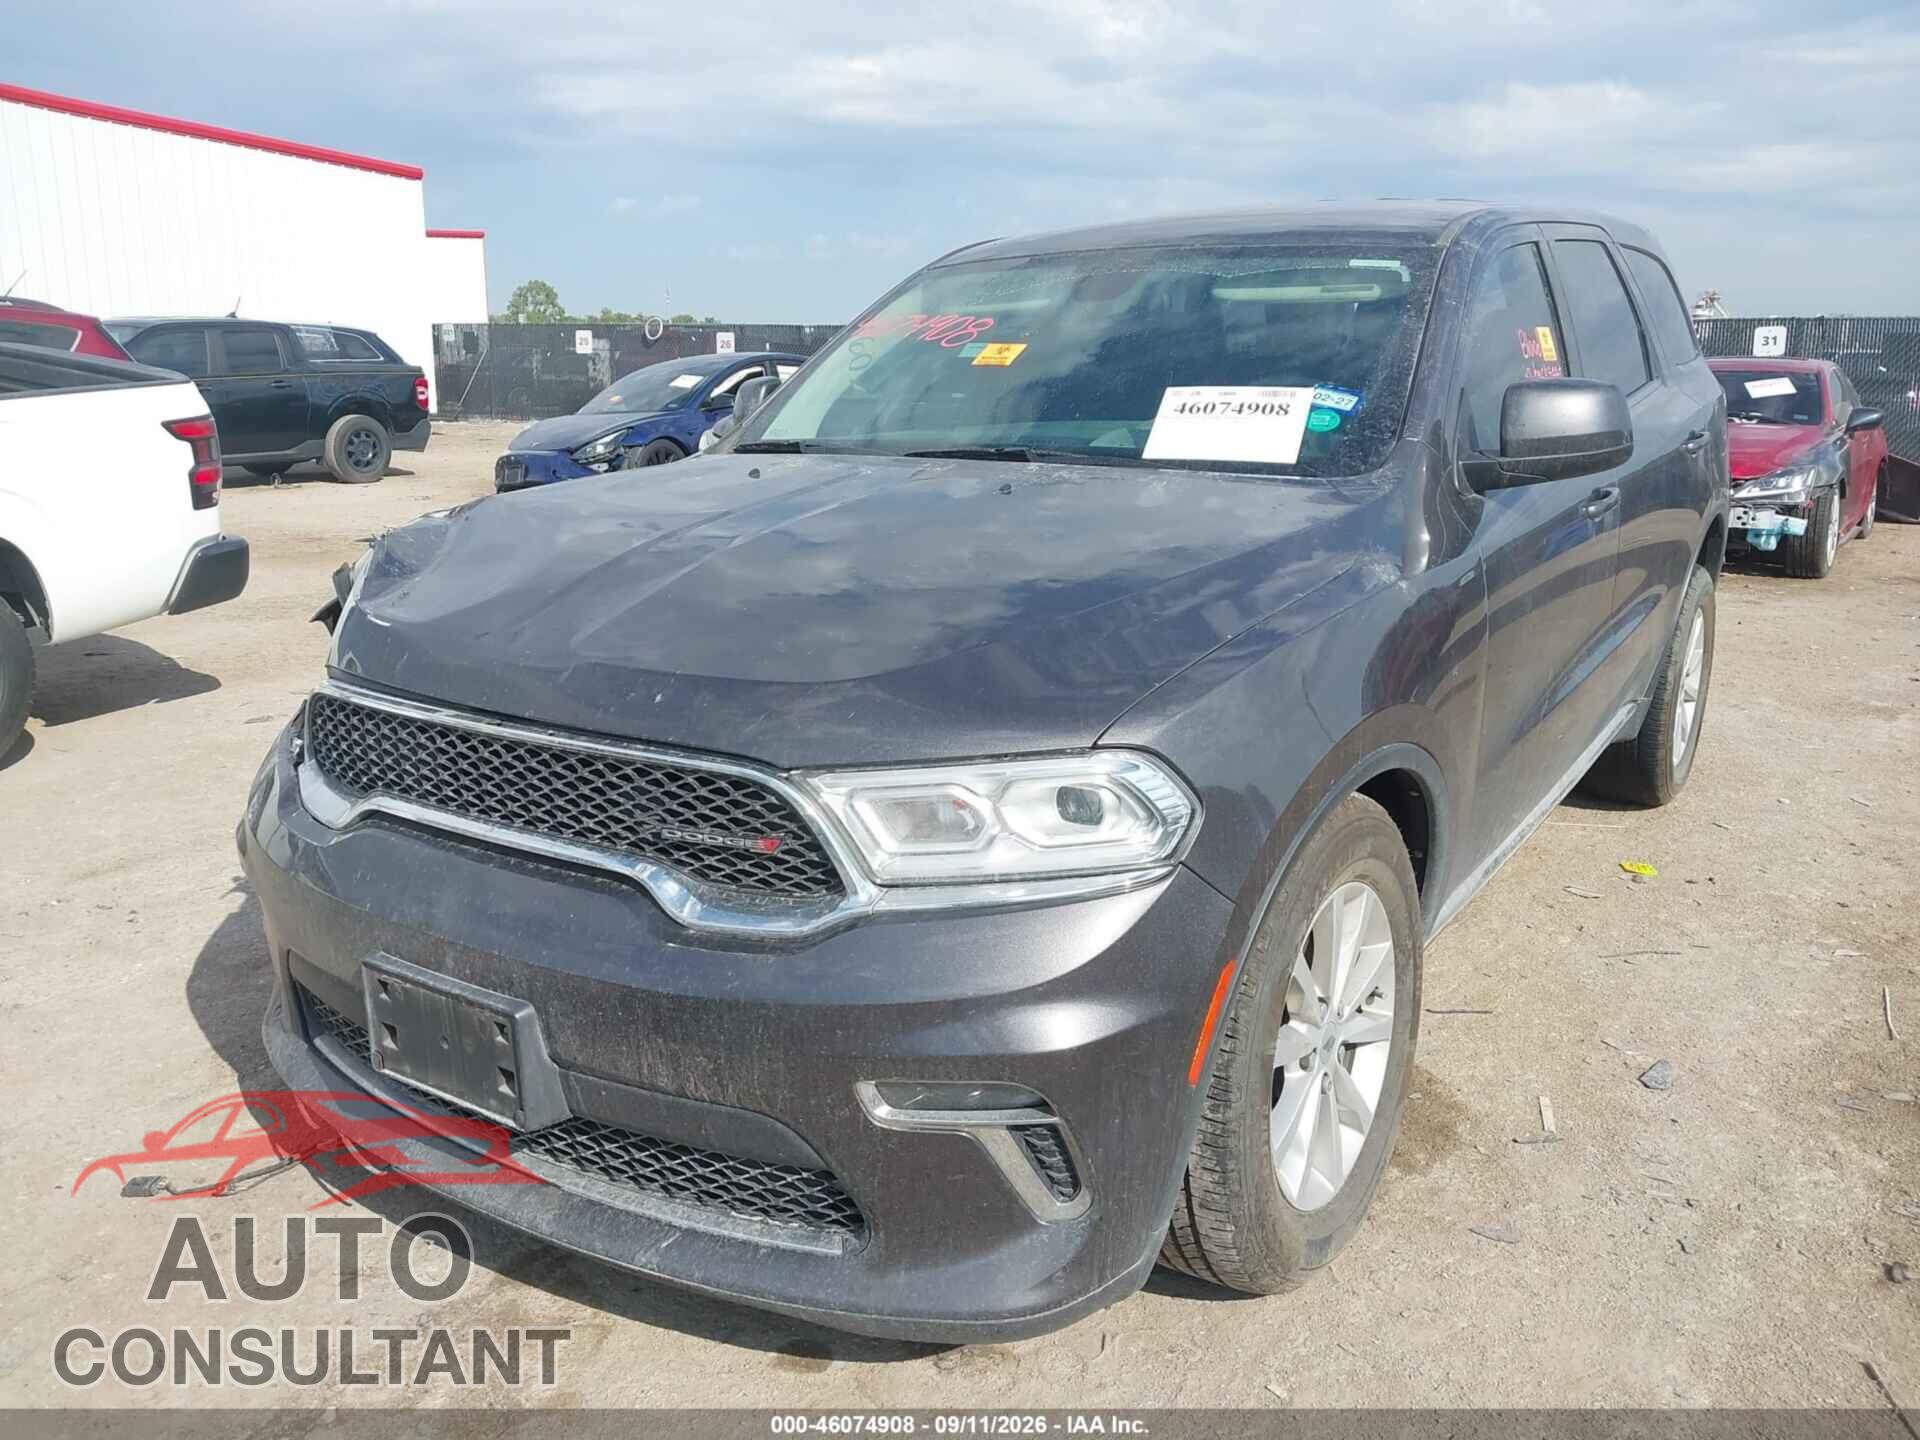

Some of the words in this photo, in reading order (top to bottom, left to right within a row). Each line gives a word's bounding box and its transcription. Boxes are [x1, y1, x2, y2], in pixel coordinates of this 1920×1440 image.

[719, 339, 732, 349] 26
[1761, 335, 1778, 346] 31
[1173, 401, 1291, 416] 46074908
[661, 829, 763, 850] DODGE
